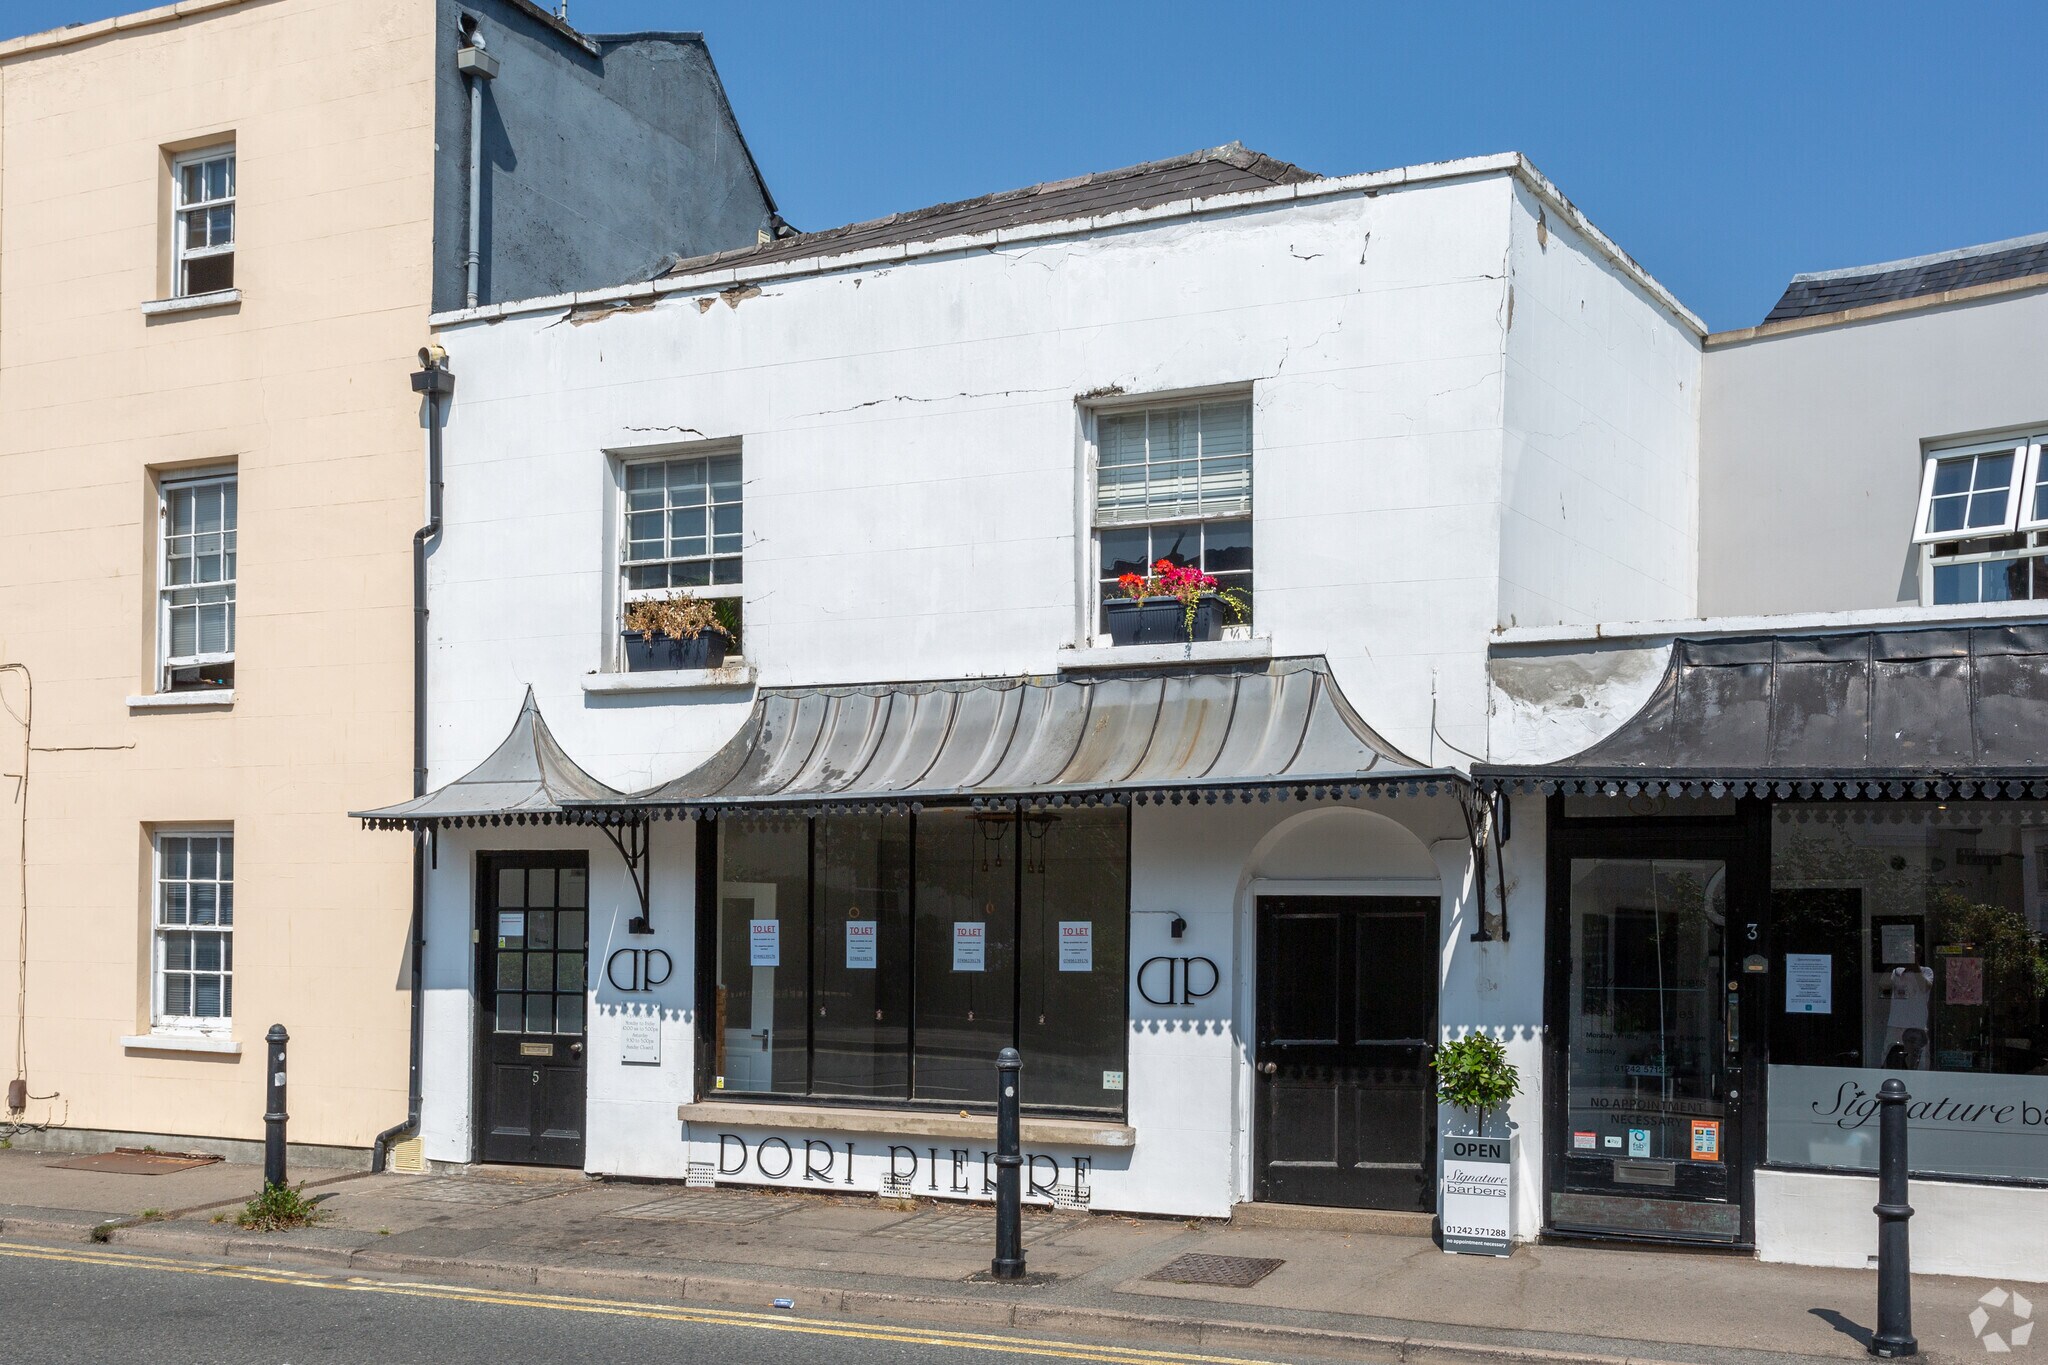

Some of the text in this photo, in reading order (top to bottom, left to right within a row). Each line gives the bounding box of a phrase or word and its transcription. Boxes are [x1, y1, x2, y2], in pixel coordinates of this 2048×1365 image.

[753, 925, 776, 933] TO LET
[849, 927, 873, 935] TO LET
[957, 928, 982, 936] TO LET
[1063, 927, 1088, 936] TO LET
[1747, 923, 1757, 940] 3
[1644, 1065, 1675, 1073] 5712
[532, 1070, 539, 1083] 5
[1590, 1098, 1704, 1112] NO APPOINTMENT
[1812, 1081, 2015, 1129] Sigature
[1611, 1114, 1683, 1127] NECESSARY
[1453, 1142, 1501, 1158] OPEN
[717, 1133, 855, 1185] DORI
[1446, 1169, 1508, 1185] Signature
[1446, 1184, 1507, 1196] barbers
[1446, 1225, 1506, 1238] 01242 571288
[1483, 1241, 1507, 1249] necessary
